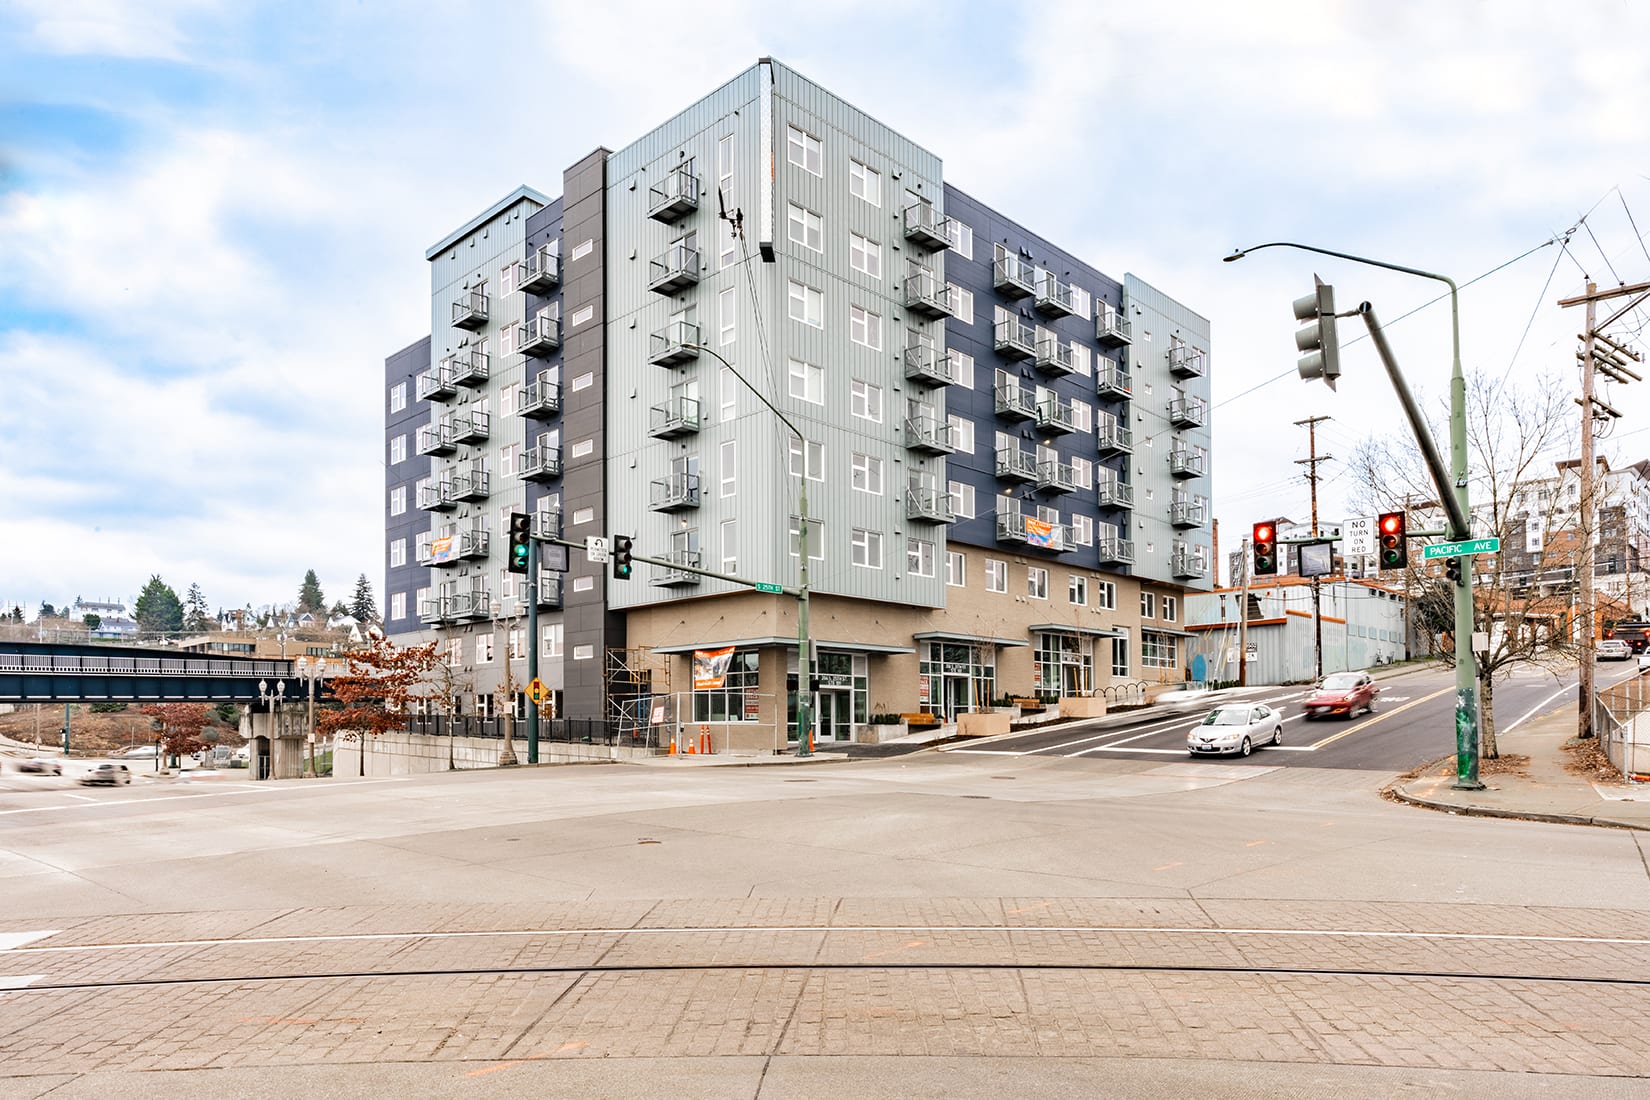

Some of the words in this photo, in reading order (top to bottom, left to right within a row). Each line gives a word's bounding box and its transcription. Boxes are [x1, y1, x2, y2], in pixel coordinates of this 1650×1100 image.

[1352, 520, 1366, 528] NO
[1430, 544, 1462, 556] PACIFIC
[1474, 541, 1492, 550] AVE
